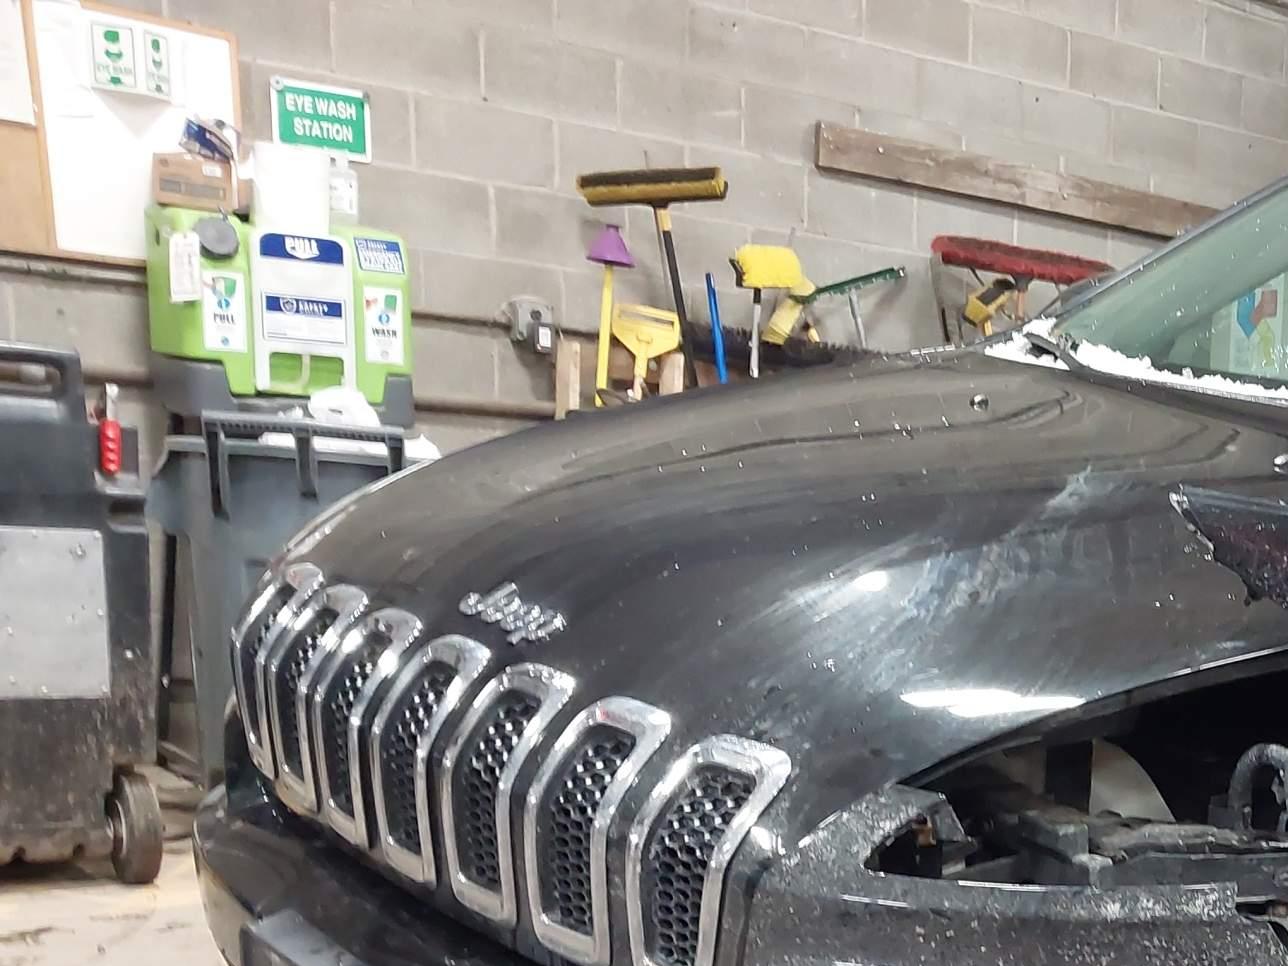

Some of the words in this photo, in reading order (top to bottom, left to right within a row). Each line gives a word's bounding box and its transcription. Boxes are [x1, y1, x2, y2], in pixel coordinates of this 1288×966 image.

[285, 91, 313, 114] EYE
[314, 96, 356, 121] WASH
[293, 116, 353, 143] STATION
